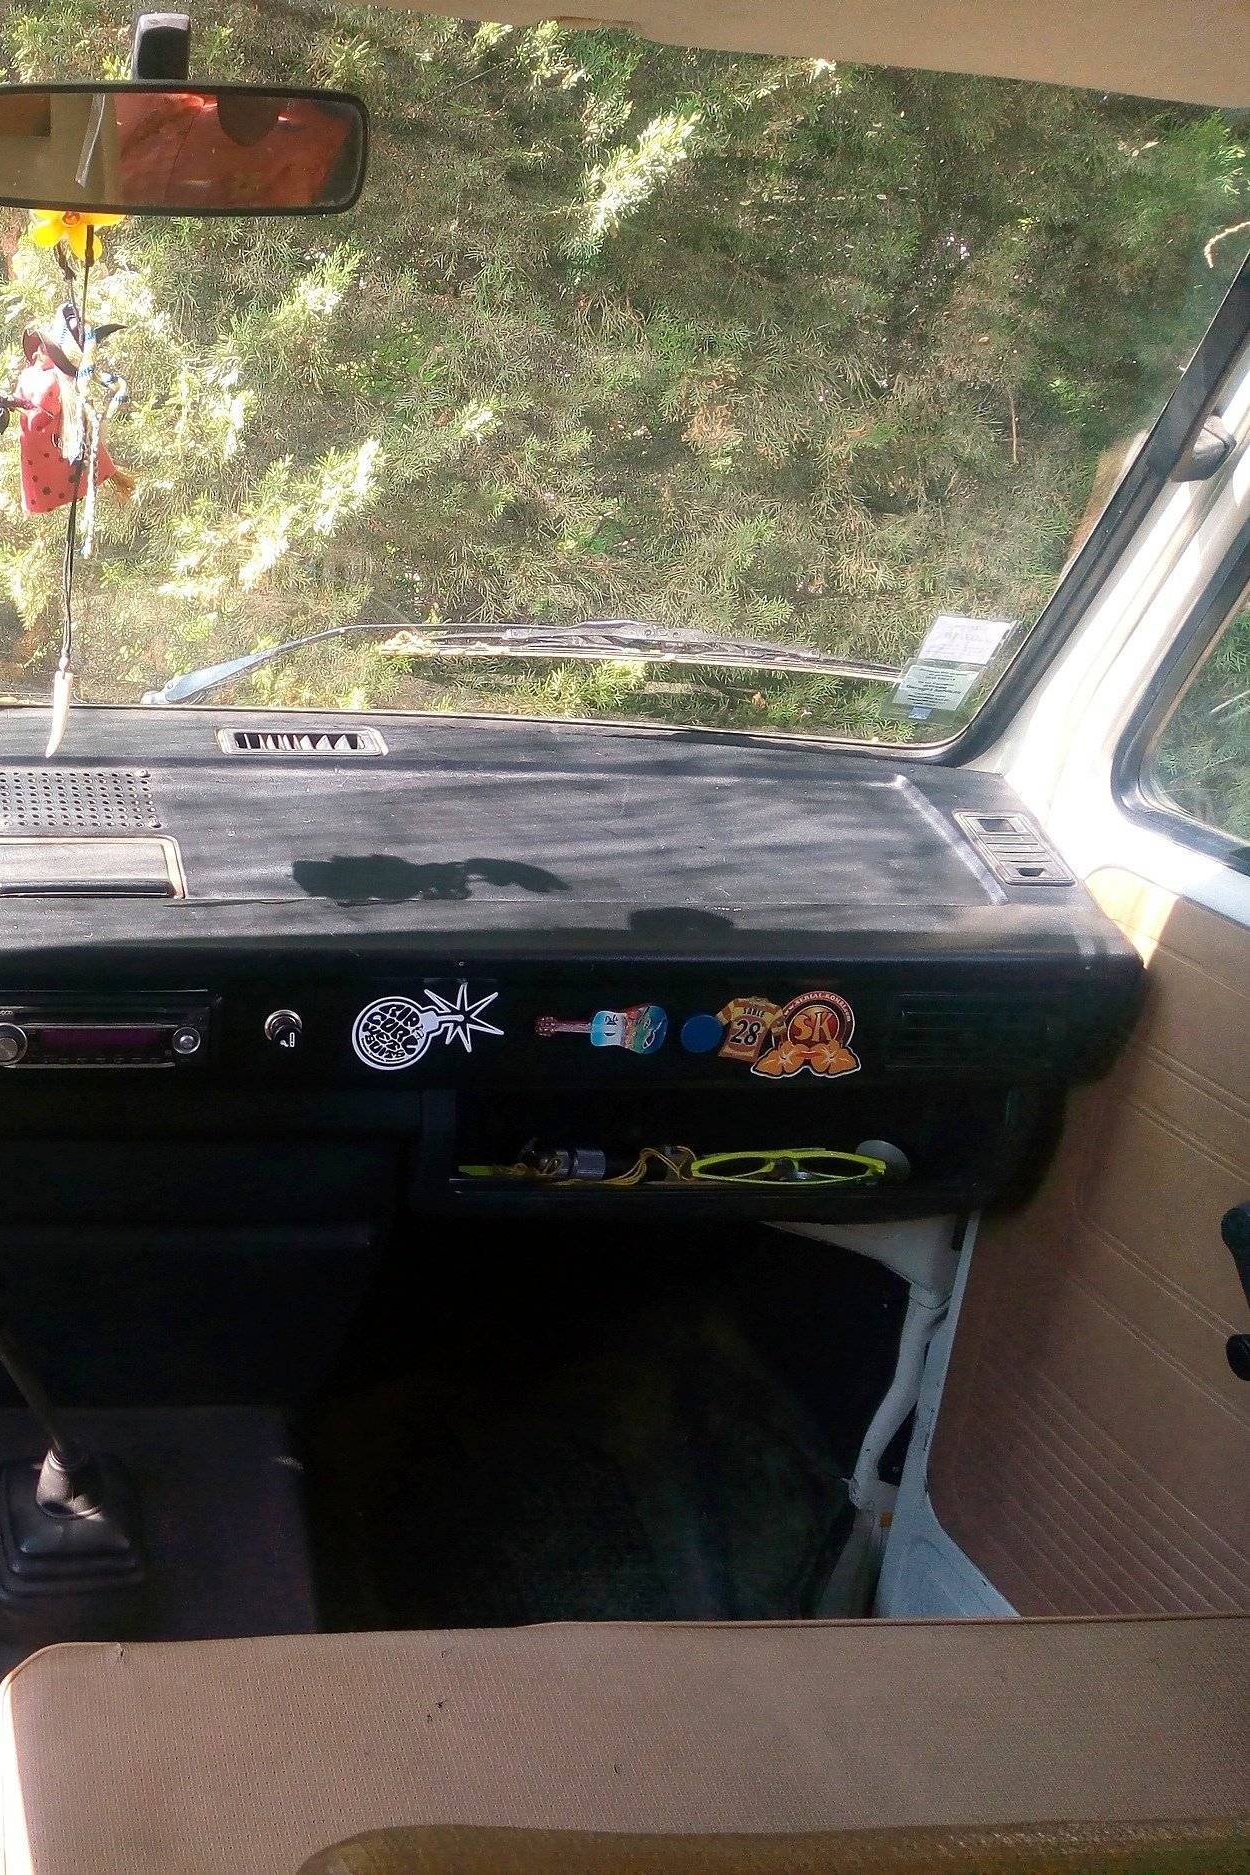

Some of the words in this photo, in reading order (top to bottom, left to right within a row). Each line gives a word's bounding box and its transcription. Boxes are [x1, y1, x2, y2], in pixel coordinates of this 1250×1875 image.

[378, 1003, 420, 1028] RIP
[793, 1010, 835, 1042] SK
[366, 1012, 419, 1056] CURL
[729, 1018, 762, 1046] 28
